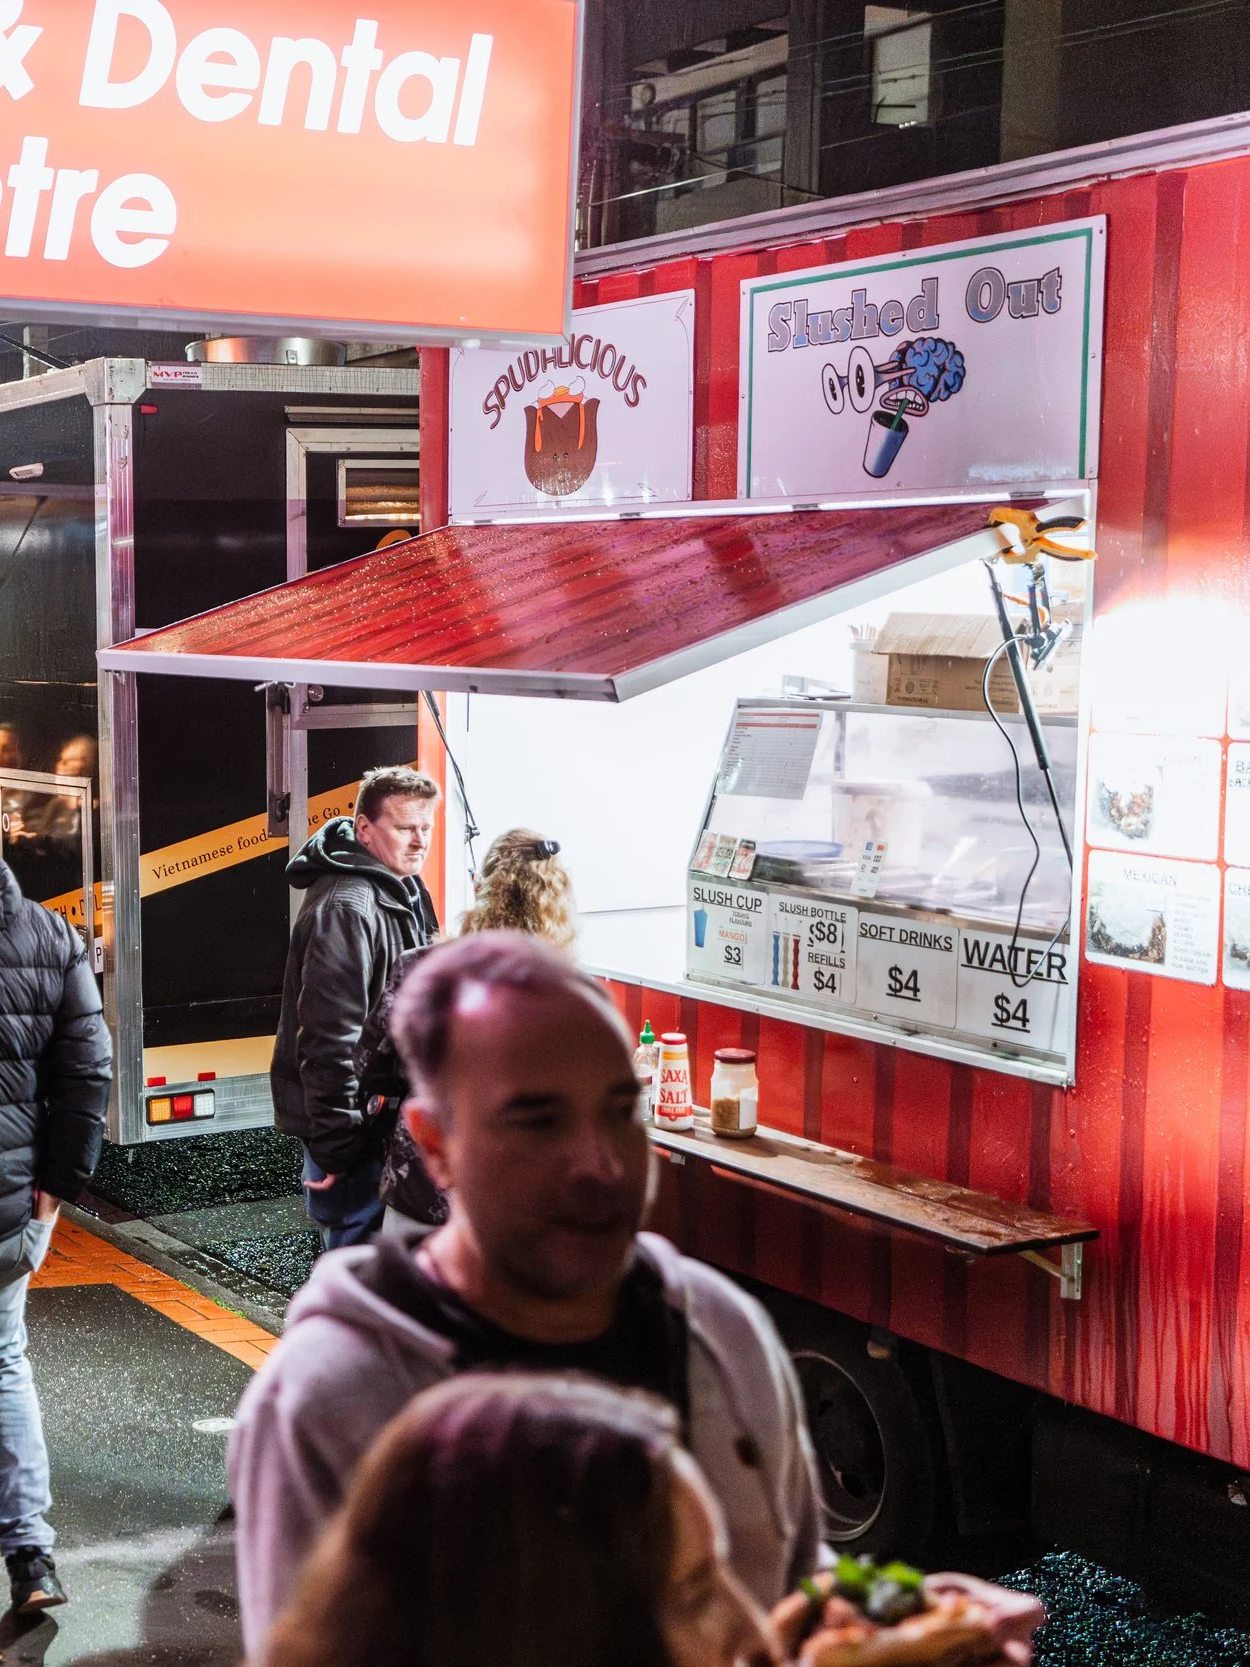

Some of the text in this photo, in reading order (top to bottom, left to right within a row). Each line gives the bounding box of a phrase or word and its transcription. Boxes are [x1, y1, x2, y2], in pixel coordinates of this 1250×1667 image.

[79, 0, 494, 146] Dental
[768, 266, 1062, 353] Slushed Out
[322, 807, 341, 820] Go
[152, 829, 269, 881] Vietnamese food
[1123, 868, 1178, 888] MEXICAN
[693, 887, 762, 911] SLUSH CUP
[779, 902, 847, 922] SLUSH BOTTLE
[718, 929, 745, 942] MANGO
[814, 919, 838, 946] $8
[859, 922, 953, 951] SOFT DRINKS
[724, 945, 742, 964] $3
[807, 952, 846, 969] REFILLS
[963, 937, 1068, 981] WATER
[813, 967, 837, 994] $4
[888, 963, 921, 998] $4
[993, 992, 1031, 1028] $4
[660, 1069, 688, 1084] SAXA
[659, 1088, 688, 1104] SALT
